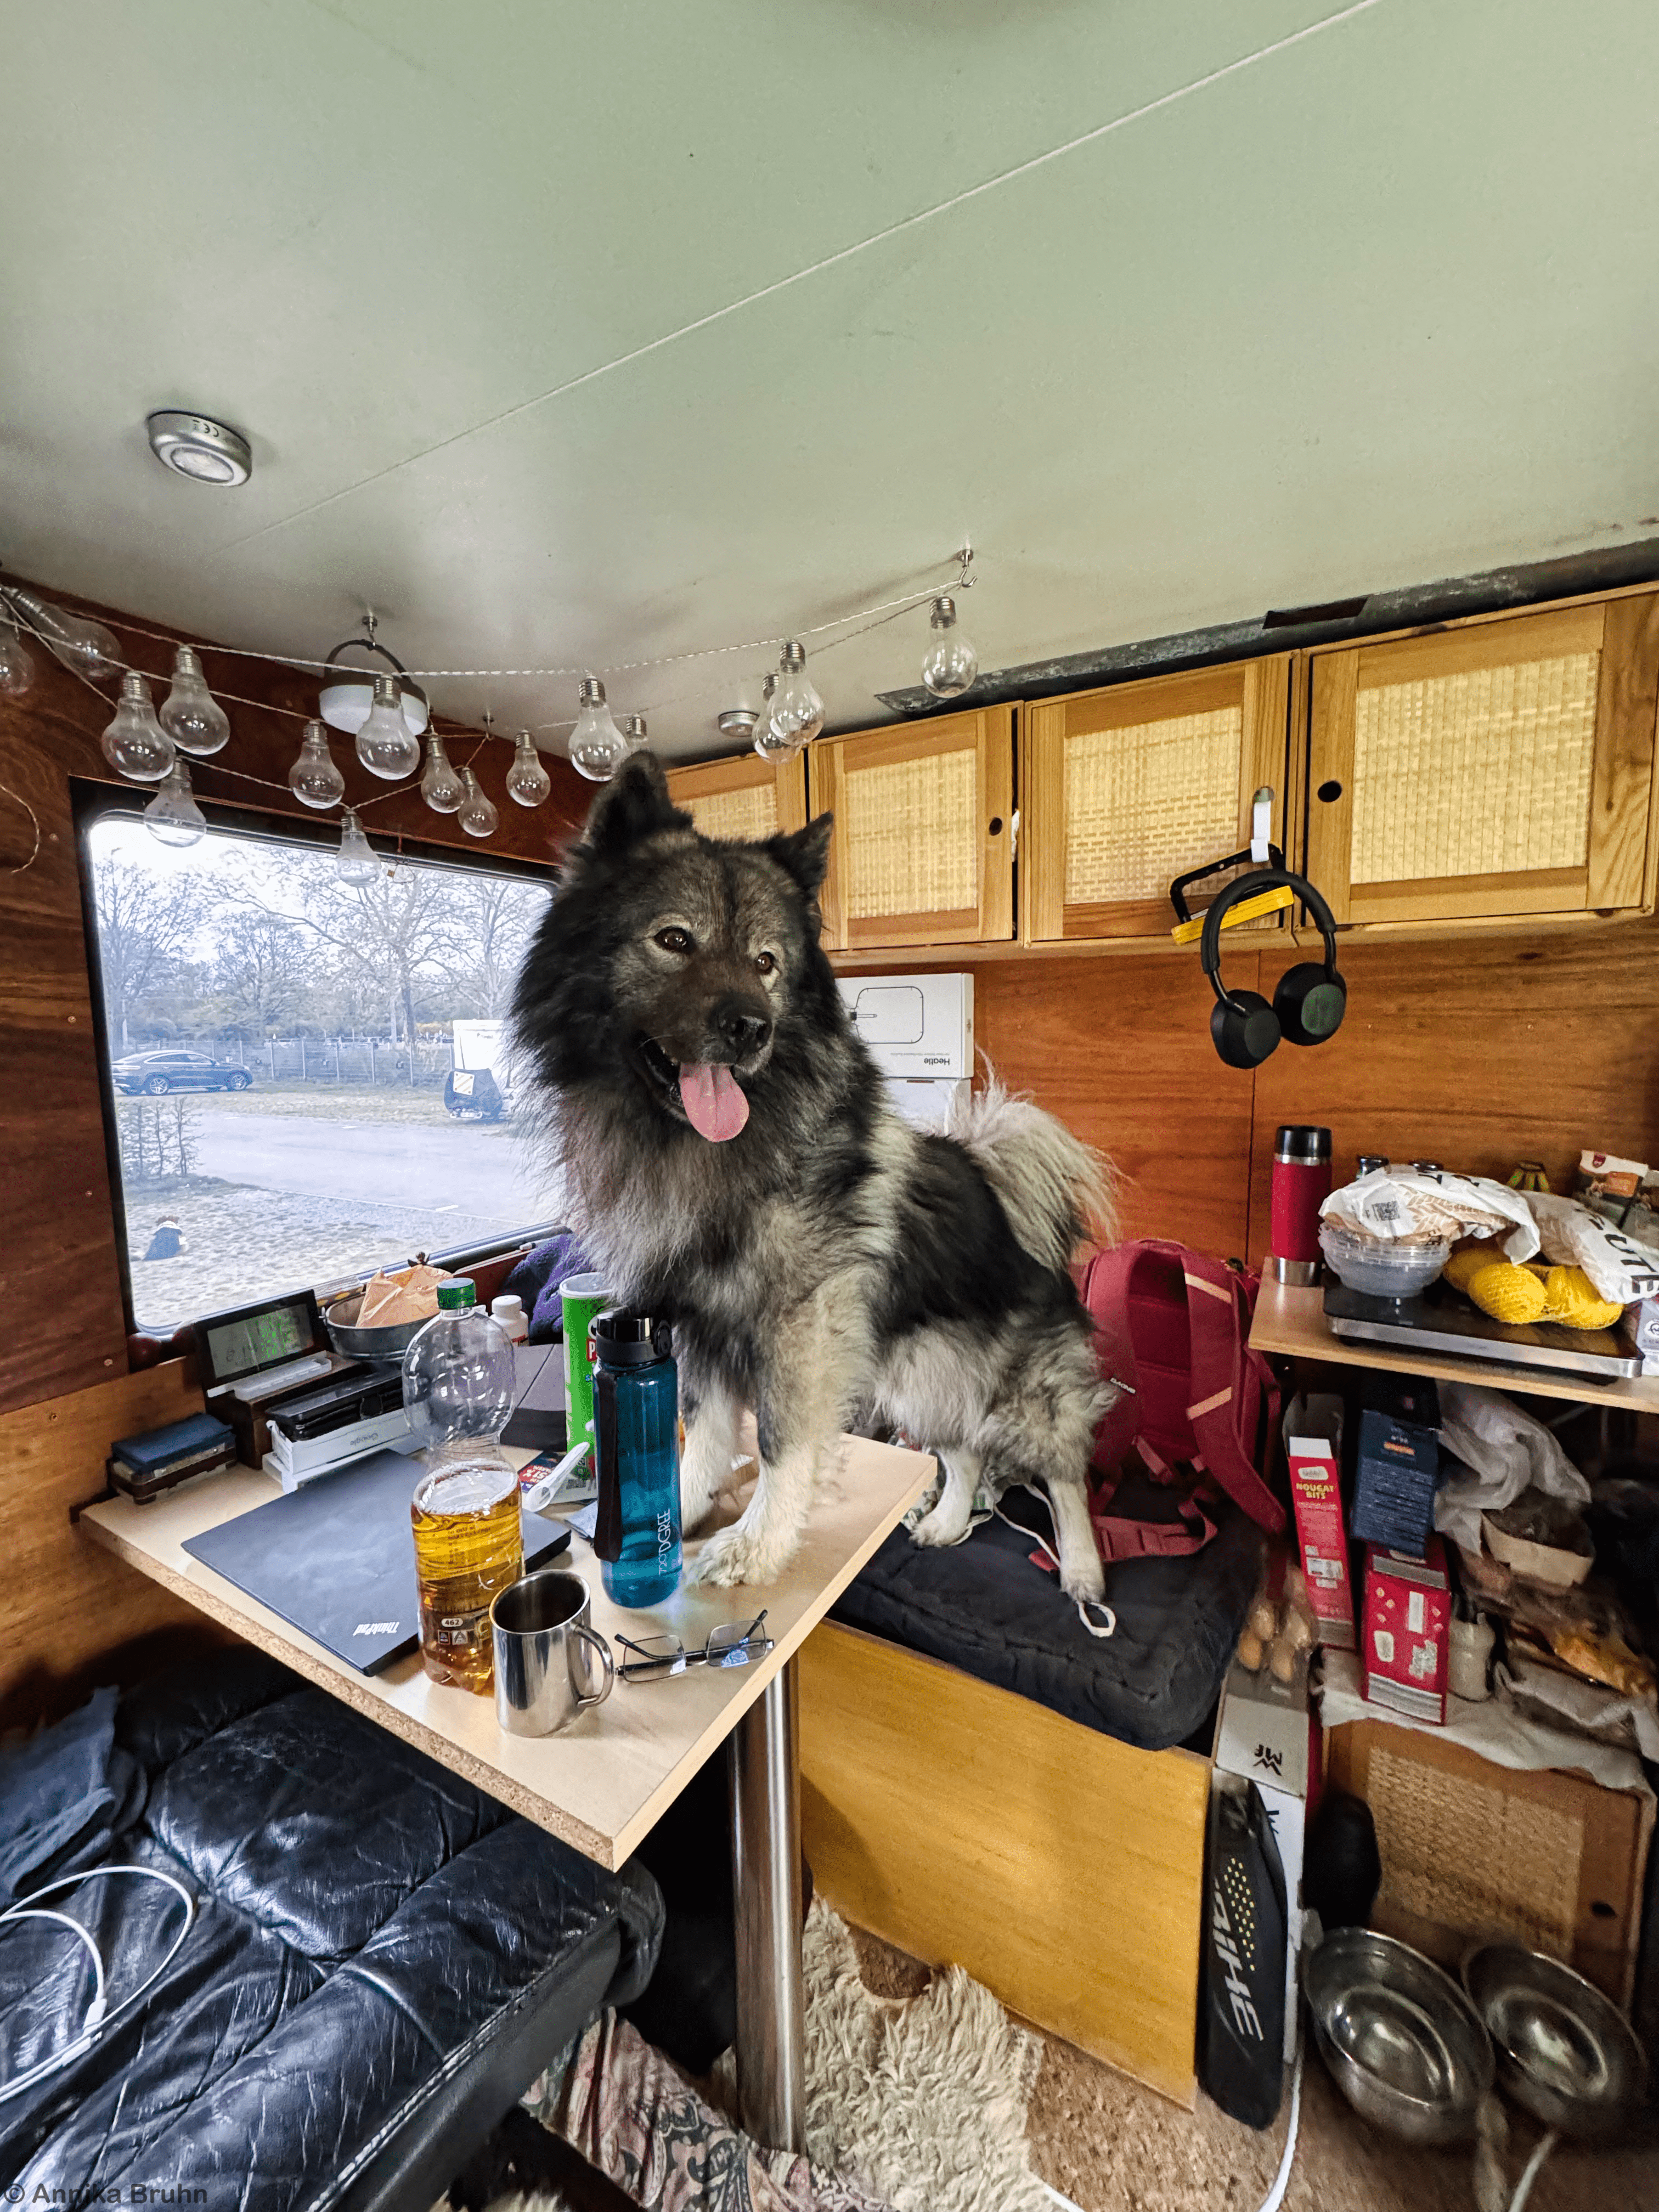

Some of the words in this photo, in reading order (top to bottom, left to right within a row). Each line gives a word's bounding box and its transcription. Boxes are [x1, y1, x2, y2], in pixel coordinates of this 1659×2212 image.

[924, 1058, 950, 1066] Heatle
[349, 1433, 379, 1446] Google
[1295, 1482, 1335, 1493] NOUGAT
[1305, 1491, 1327, 1499] BITS
[353, 1621, 400, 1638] ThinkPad
[1253, 1744, 1282, 1776] WMF
